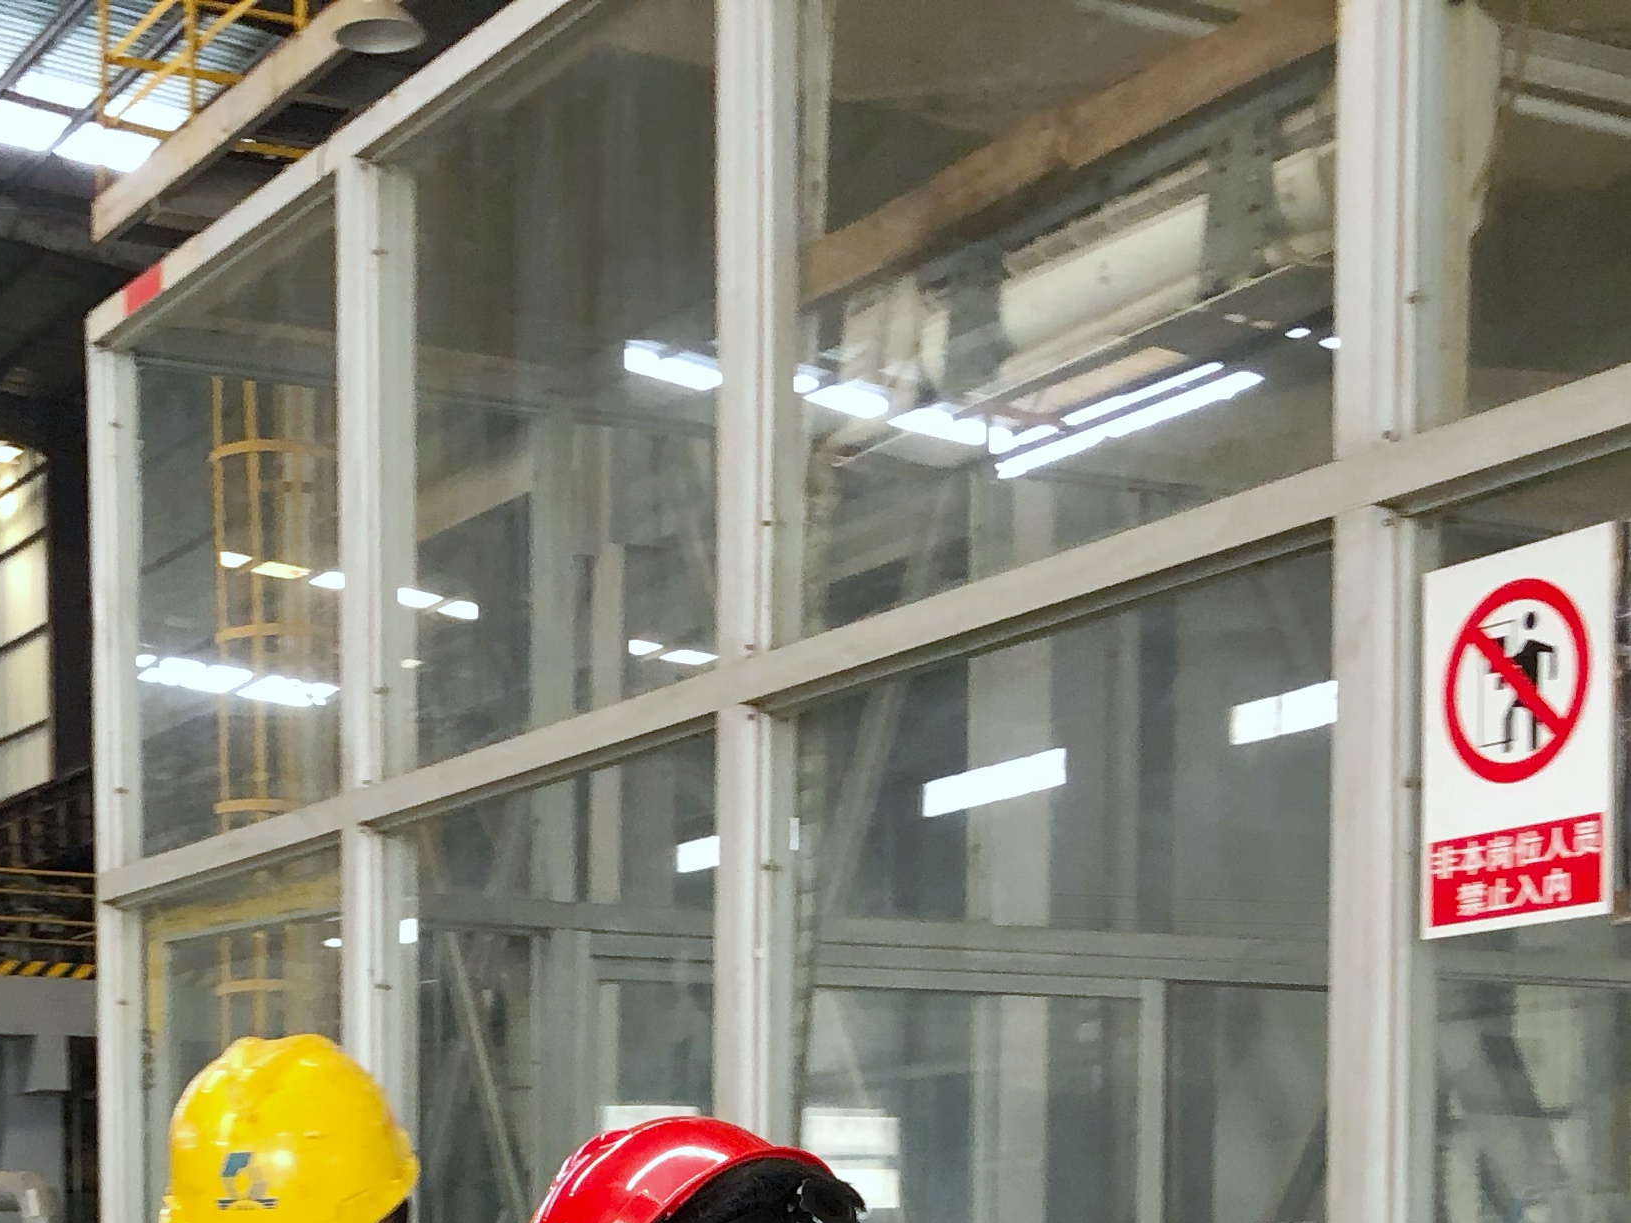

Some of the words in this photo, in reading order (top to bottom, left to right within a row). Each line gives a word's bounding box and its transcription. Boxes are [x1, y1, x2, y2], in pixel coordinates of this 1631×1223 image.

[1431, 819, 1603, 879] 非本岗位人员
[1455, 868, 1572, 916] 禁止入内
